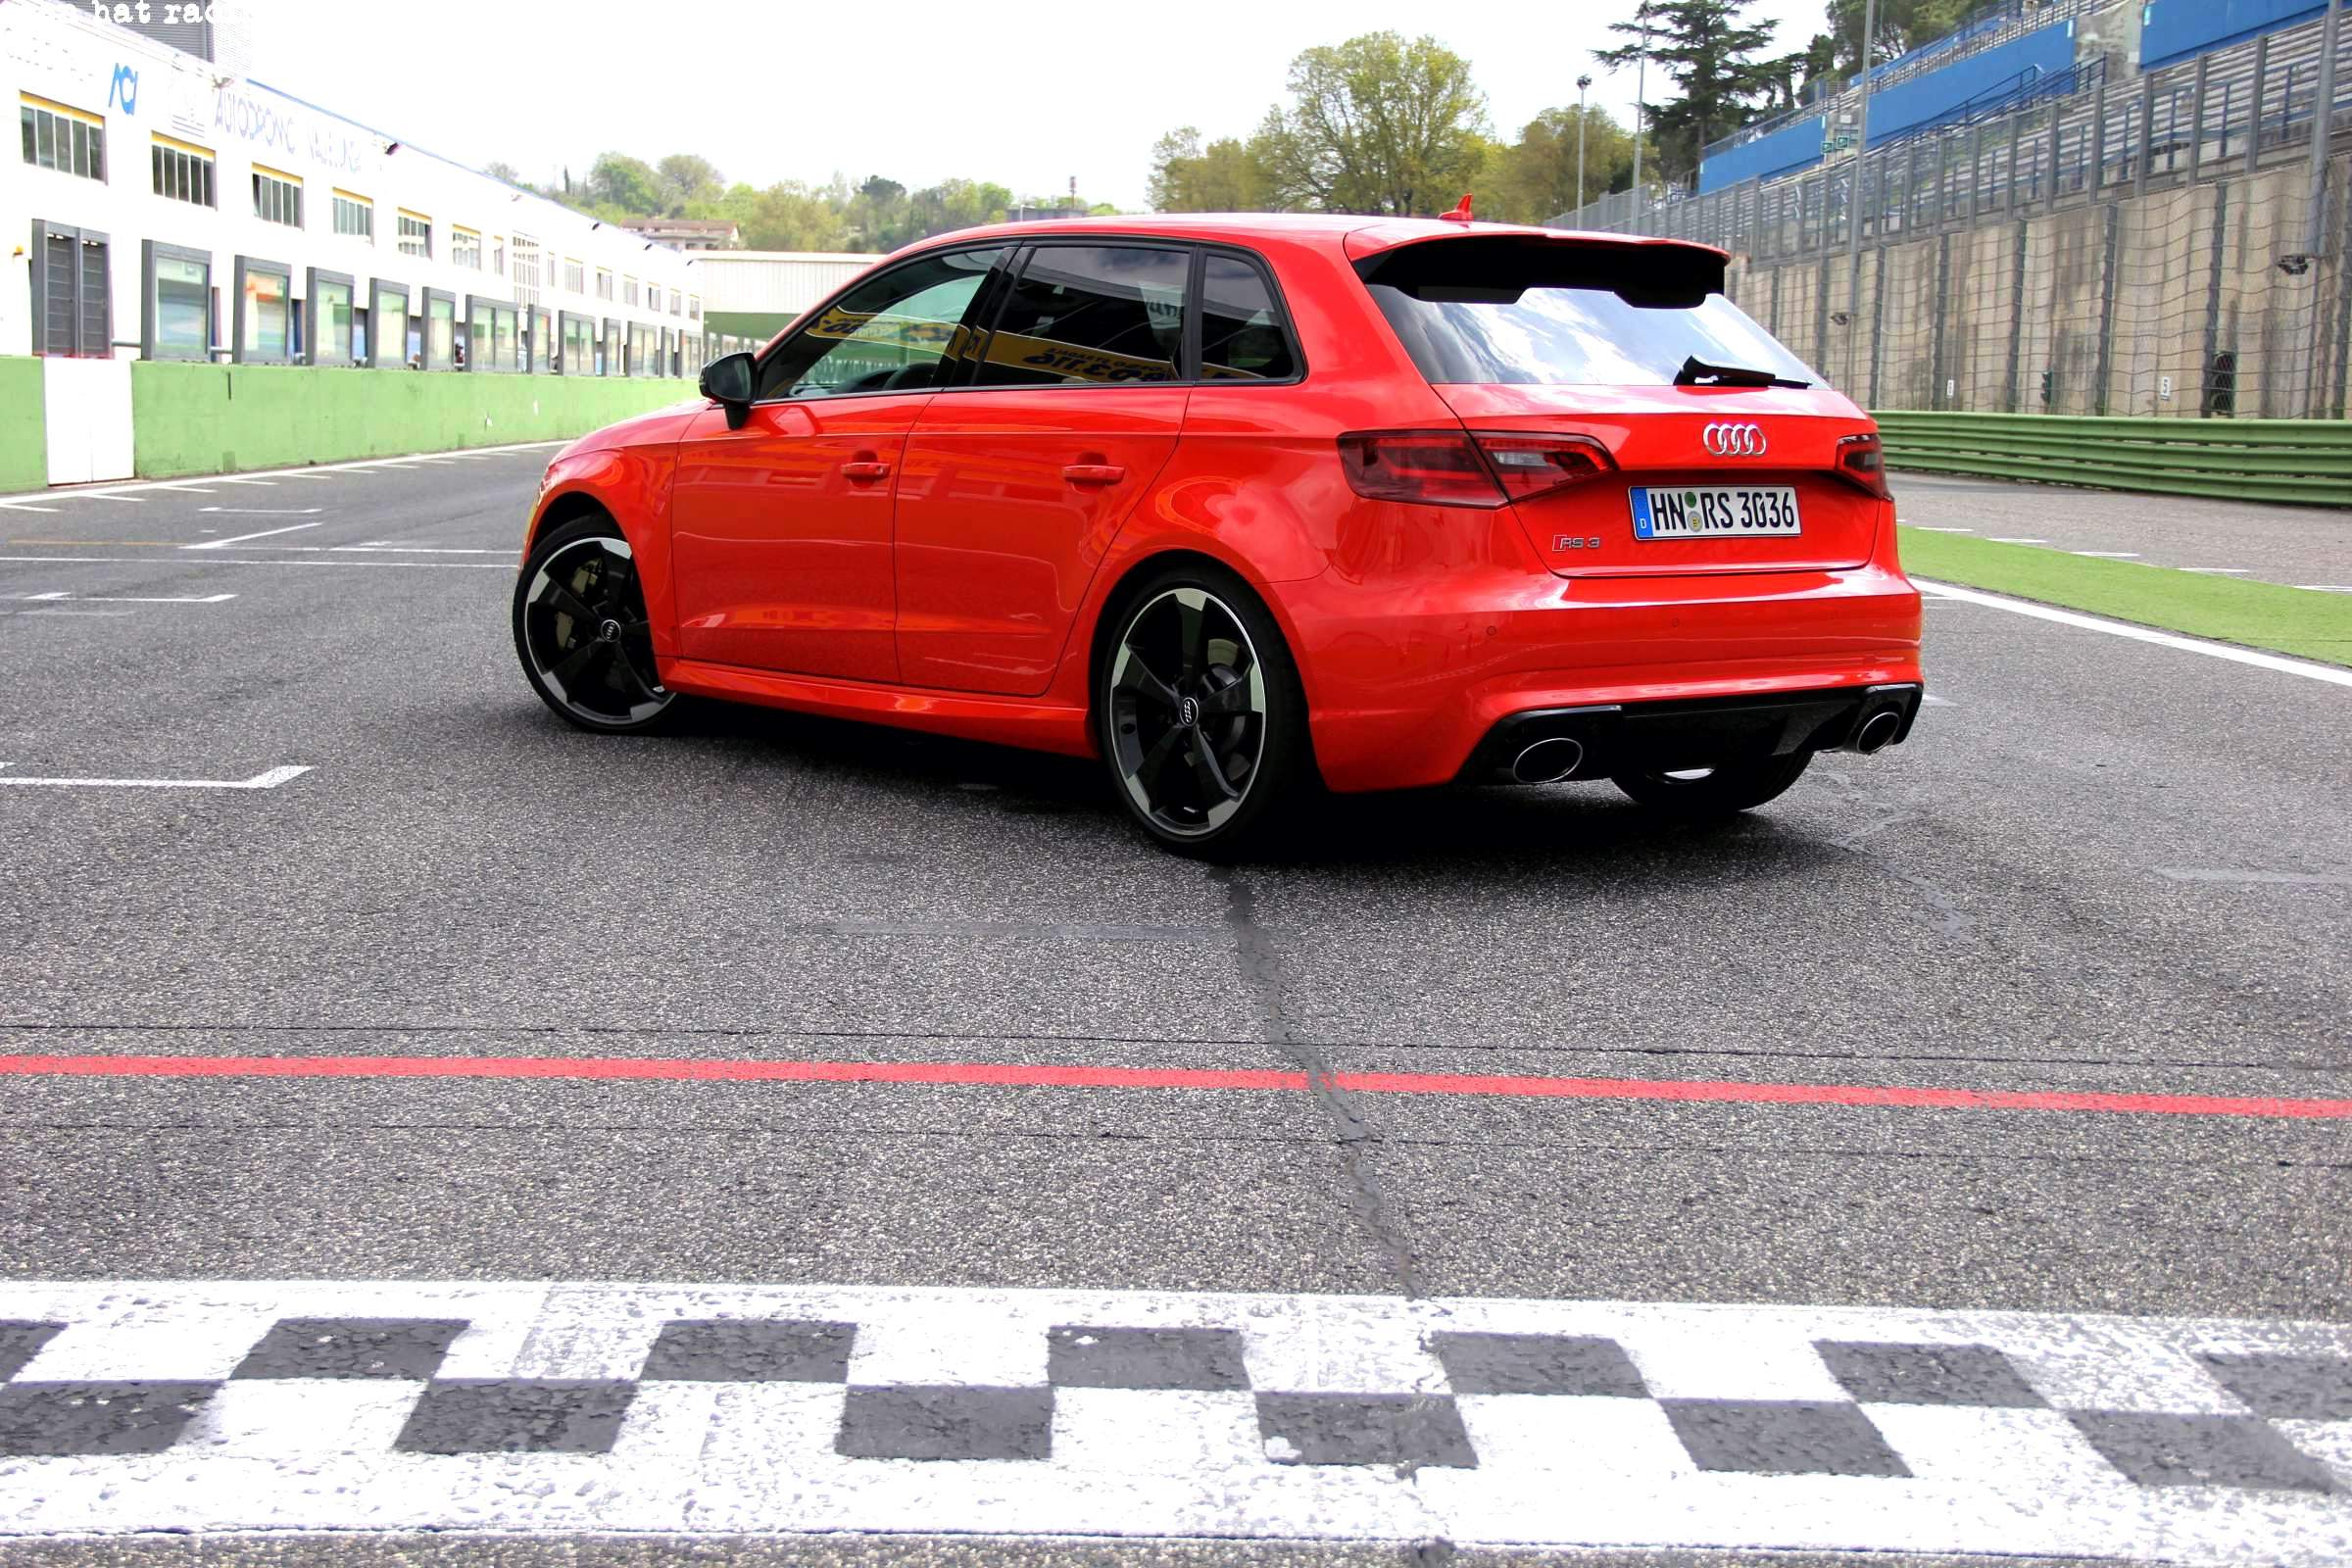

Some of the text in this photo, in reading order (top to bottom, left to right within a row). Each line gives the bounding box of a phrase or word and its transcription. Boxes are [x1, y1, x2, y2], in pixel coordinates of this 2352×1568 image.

[1650, 491, 1794, 530] HN RS 3036
[1588, 537, 1599, 549] 3
